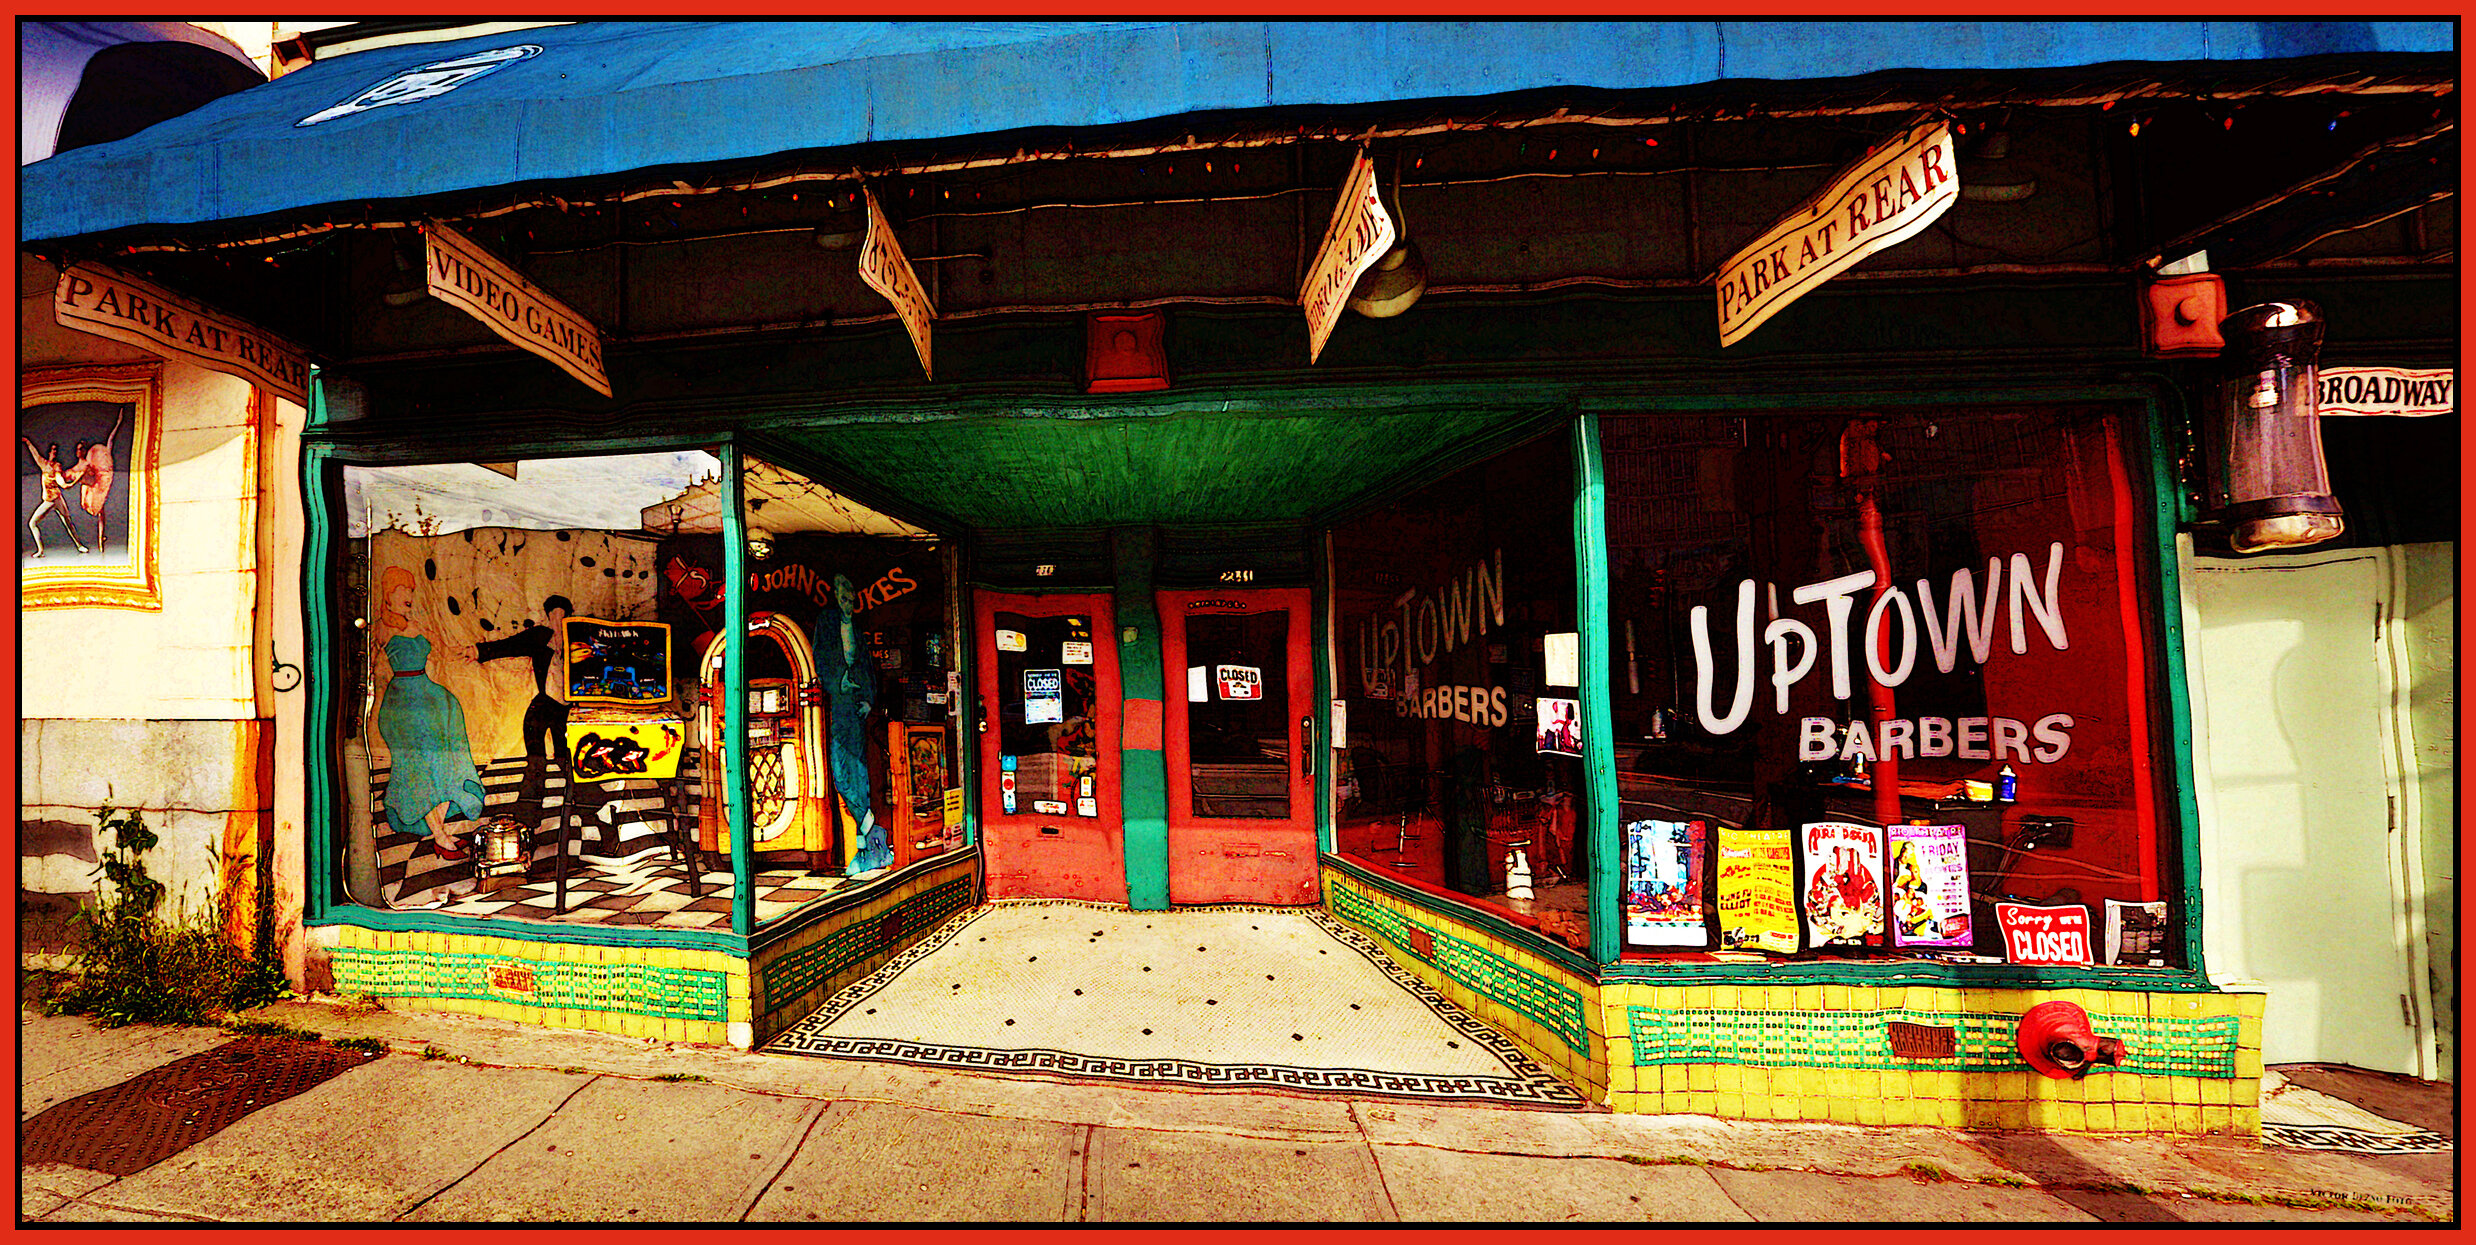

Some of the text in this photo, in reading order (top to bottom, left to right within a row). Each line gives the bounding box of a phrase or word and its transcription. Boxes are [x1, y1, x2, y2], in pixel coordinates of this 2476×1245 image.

[1719, 143, 1948, 324] PARK AT REAR
[63, 275, 307, 390] PARK AT REAR
[432, 246, 602, 372] VIDEO GAMES
[762, 563, 917, 614] JOHN'S UKES
[1359, 547, 1505, 693] UPTOWN
[1691, 541, 2069, 735] UPTOWN
[1220, 668, 1258, 684] CLOSED
[1396, 685, 1508, 728] BARBERS
[1799, 713, 2075, 764] BARBERS
[1922, 841, 1960, 857] FRIDAY
[2006, 907, 2053, 931] Sorry
[2012, 929, 2084, 962] CLOSED
